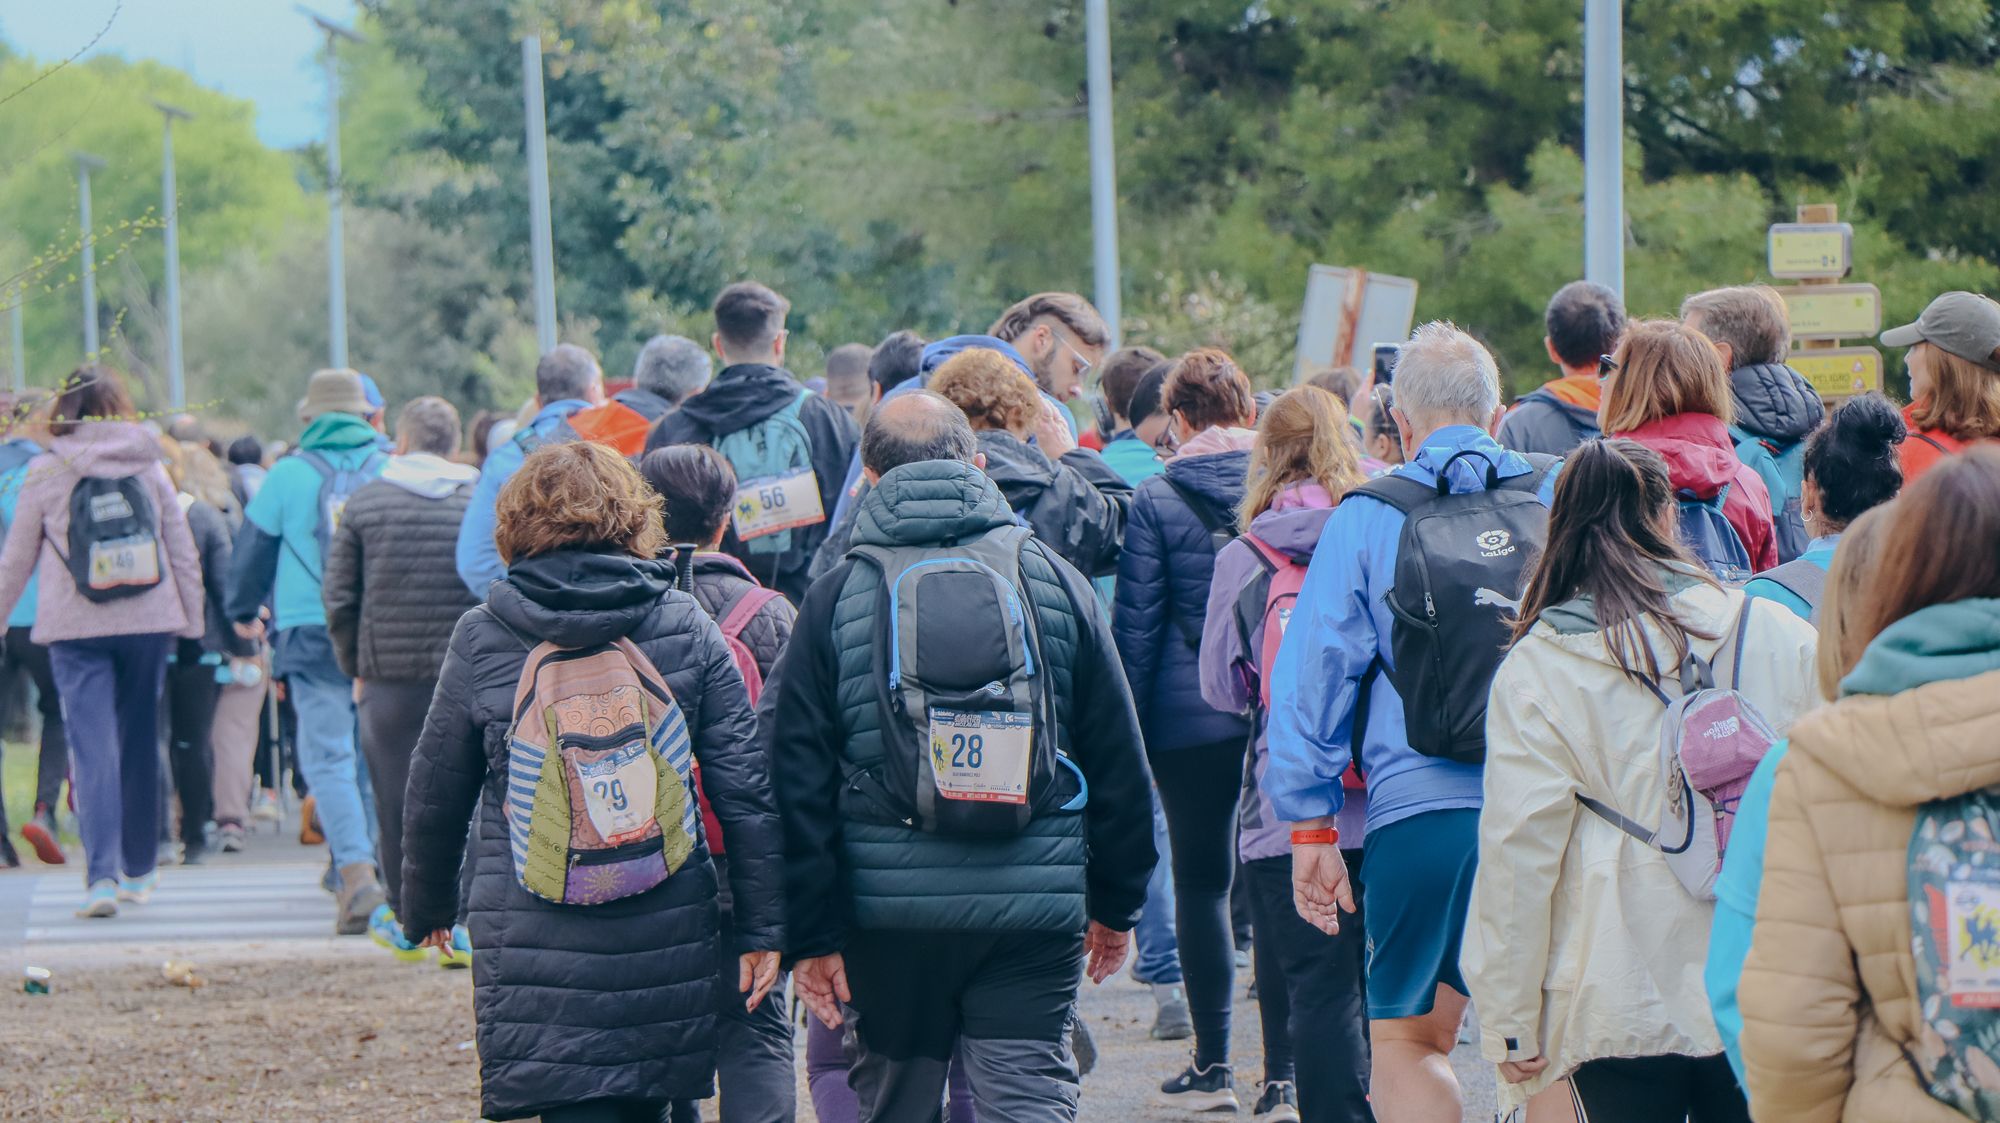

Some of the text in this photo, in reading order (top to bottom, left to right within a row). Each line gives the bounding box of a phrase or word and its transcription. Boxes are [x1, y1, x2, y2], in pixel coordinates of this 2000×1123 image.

[759, 486, 785, 510] 56
[1480, 545, 1515, 557] LaLiga
[1703, 724, 1730, 738] NORTH
[1711, 720, 1728, 729] THE
[1713, 728, 1732, 740] FACE
[951, 733, 984, 769] 28
